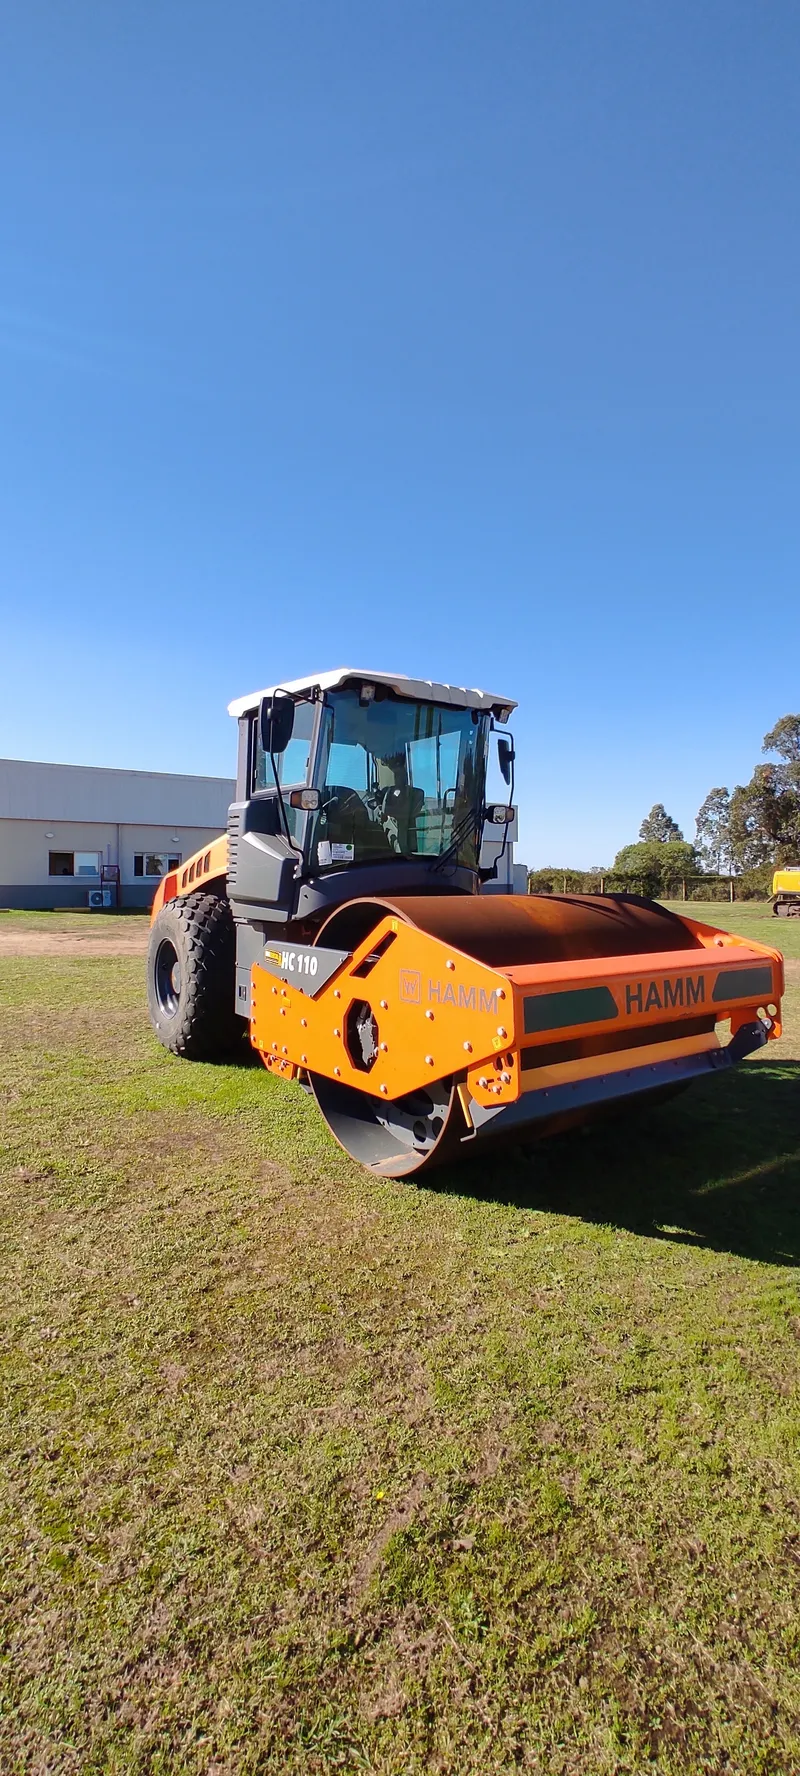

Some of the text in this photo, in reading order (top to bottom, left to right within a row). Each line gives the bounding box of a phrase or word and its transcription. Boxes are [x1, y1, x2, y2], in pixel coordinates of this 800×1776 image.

[281, 951, 296, 972] HC
[297, 954, 318, 976] 110
[428, 979, 499, 1015] HAMM
[625, 975, 705, 1015] HAMM
